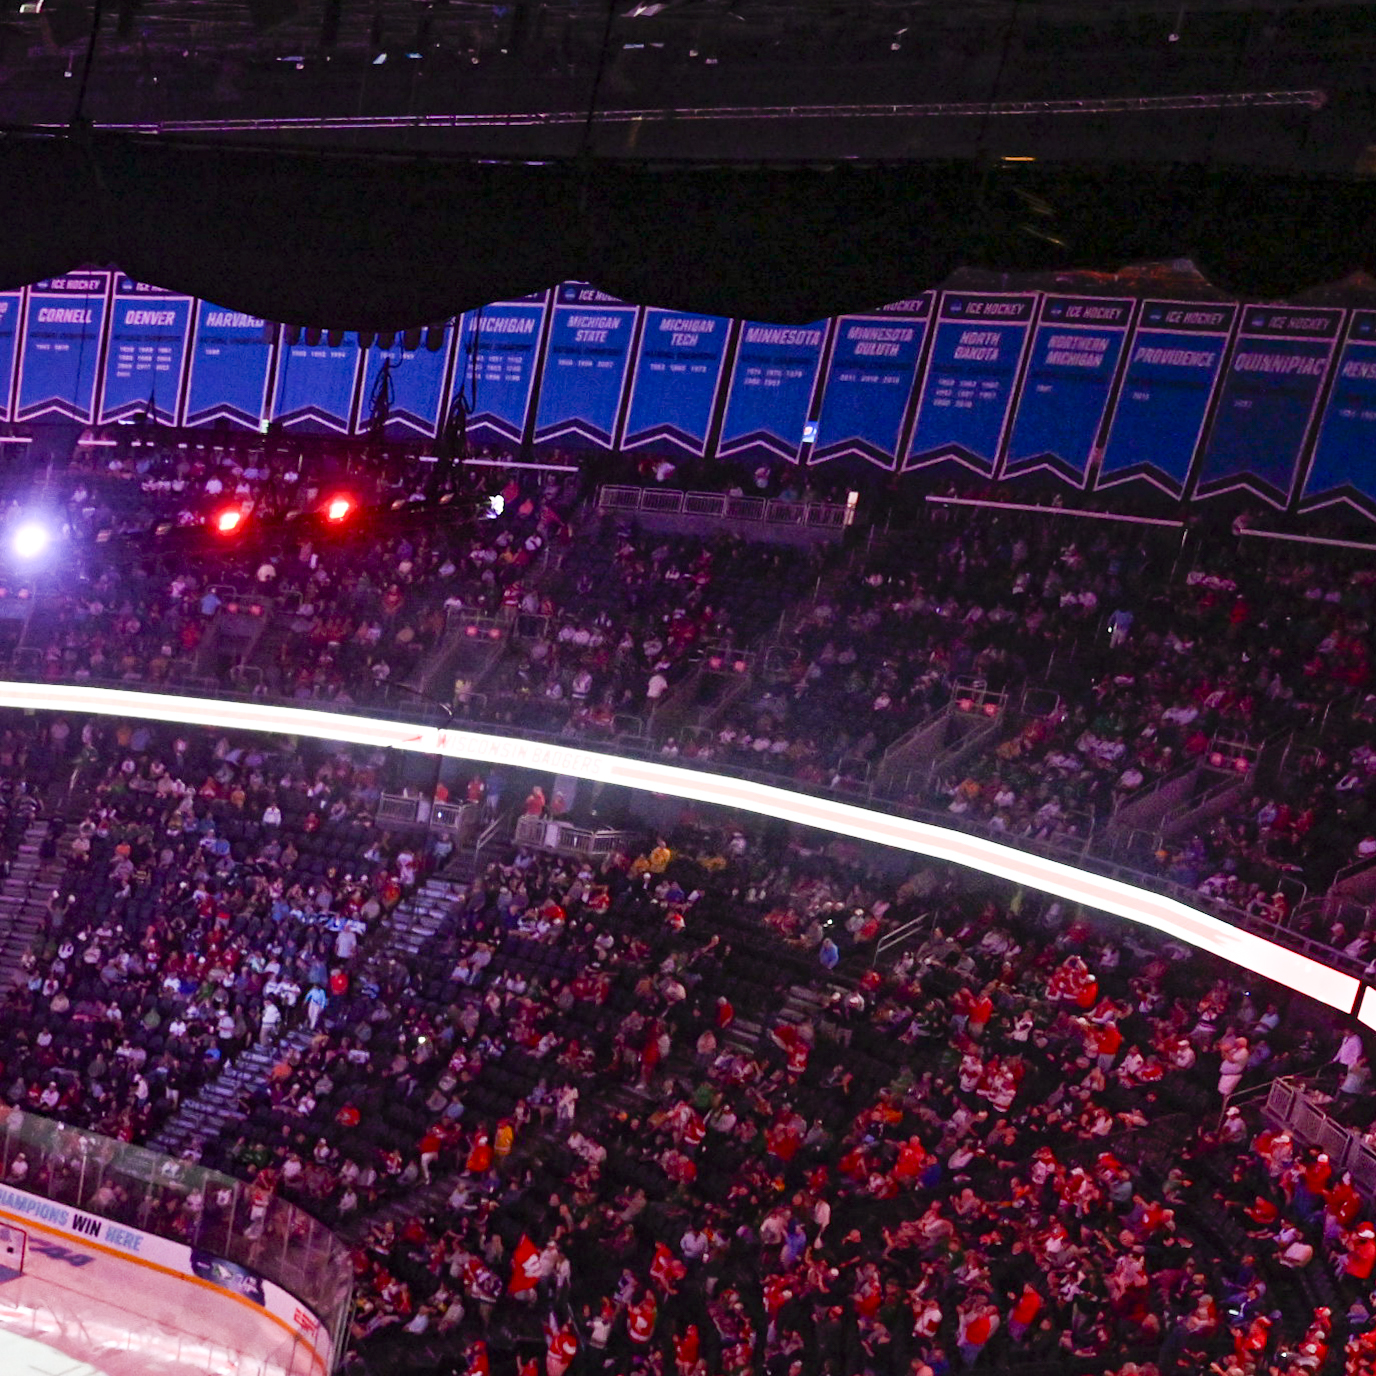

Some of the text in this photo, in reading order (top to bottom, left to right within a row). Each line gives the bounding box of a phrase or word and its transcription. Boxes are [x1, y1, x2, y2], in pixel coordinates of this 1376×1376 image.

[38, 308, 92, 323] CORNELL
[965, 302, 1025, 315] ICE HOCKEY
[1066, 305, 1123, 320] ICE HOCKEY
[125, 310, 176, 326] DENVER
[206, 312, 265, 328] HARVARD
[469, 317, 536, 334] MICHIGAN
[567, 316, 622, 329] MICHIGAN
[659, 318, 716, 333] MICHIGAN
[1165, 311, 1225, 325] ICE HOCKEY
[575, 330, 609, 343] STATE
[671, 333, 699, 346] TECH
[745, 327, 822, 346] MINNESOTA
[847, 326, 915, 342] MINNESOTA
[959, 331, 1001, 345] NORTH
[854, 342, 900, 356] DULUTH
[954, 346, 1000, 360] DAKOTA
[1046, 351, 1104, 367] MICHIGAN
[1134, 347, 1216, 367] PROVIDENCE
[1234, 353, 1328, 375] QUINNIPIAC
[532, 748, 602, 774] BADGERS
[72, 1214, 102, 1238] WIN
[105, 1225, 144, 1251] HERE
